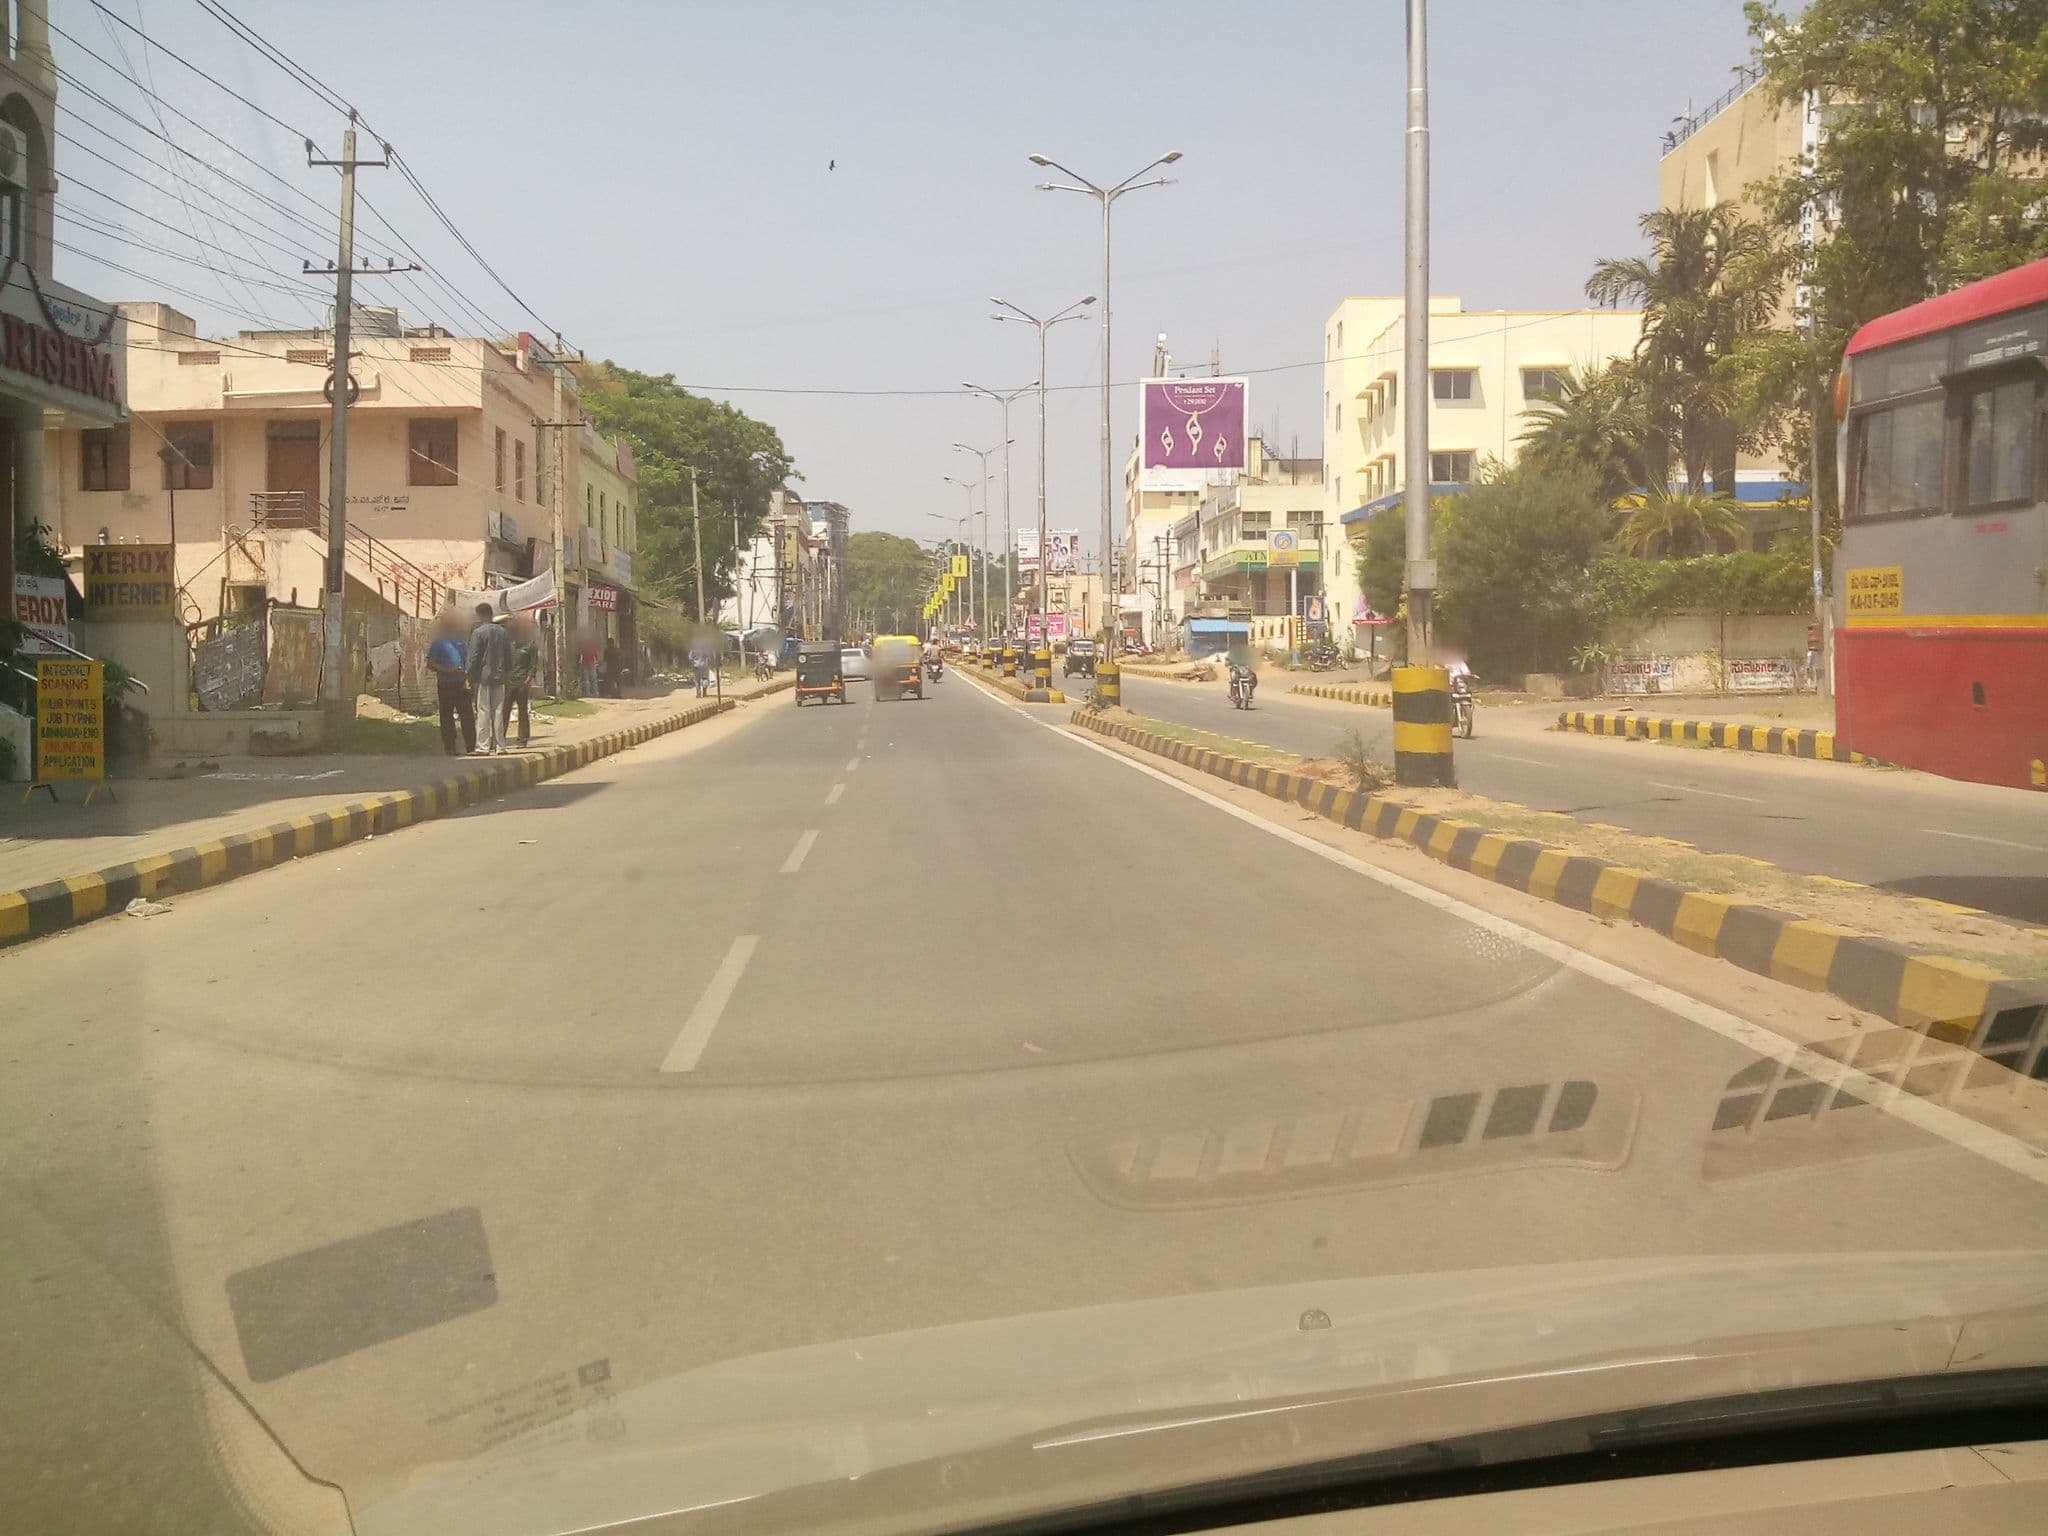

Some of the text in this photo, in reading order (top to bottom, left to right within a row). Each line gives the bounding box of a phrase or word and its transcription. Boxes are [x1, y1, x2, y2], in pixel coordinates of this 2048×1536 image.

[0, 311, 118, 404] RISHNA
[1174, 386, 1216, 394] Pendant Set
[89, 551, 169, 574] XEROX
[87, 583, 173, 606] INTERNET
[589, 600, 616, 609] CARE
[43, 664, 91, 676] INTERNET
